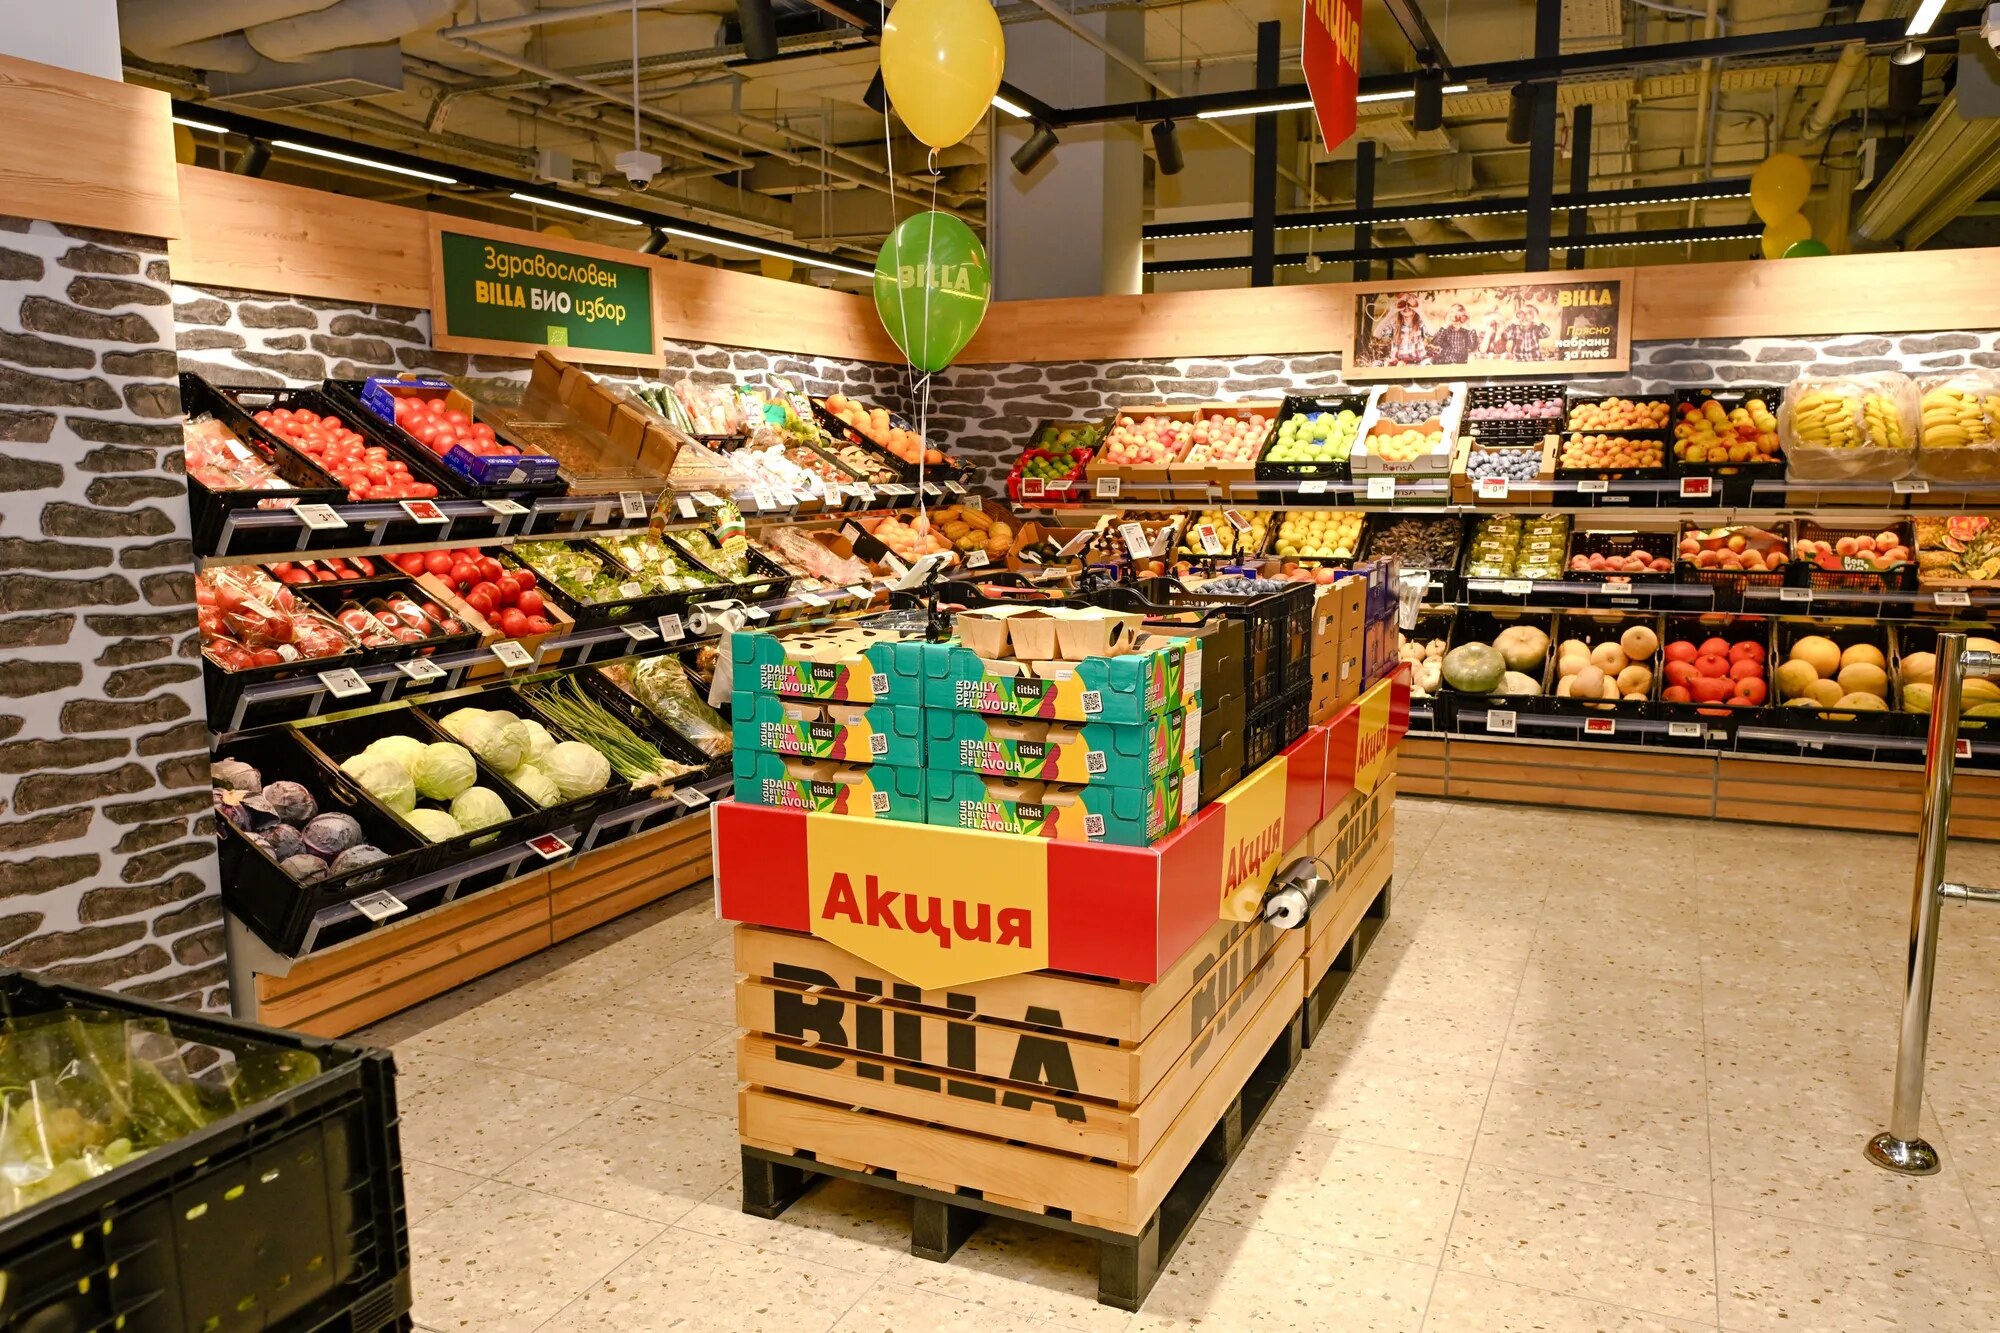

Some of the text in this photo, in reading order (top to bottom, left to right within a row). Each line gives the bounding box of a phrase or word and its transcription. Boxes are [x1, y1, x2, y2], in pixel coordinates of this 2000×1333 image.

[484, 246, 617, 288] Здравословен
[899, 264, 970, 292] BILLA
[475, 280, 626, 325] BILLA БИО избор
[1560, 289, 1612, 307] BILLA
[1566, 325, 1610, 336] Прясно
[1556, 336, 1610, 349] набрани
[1580, 347, 1609, 358] теб
[767, 664, 797, 676] DAILY
[813, 668, 834, 678] titbit
[767, 673, 778, 681] BIT
[767, 681, 815, 693] FLAVOUR
[963, 680, 997, 693] DAILY
[1016, 685, 1040, 696] titbit
[956, 680, 964, 707] YOUR
[963, 690, 976, 698] BIT
[963, 699, 1018, 712] FLAVOUR
[767, 722, 797, 734] DAILY
[812, 728, 833, 738] titbit
[767, 740, 814, 753] FLAVOUR
[960, 739, 968, 766] YOUR
[967, 740, 1002, 752] DAILY
[1019, 745, 1043, 756] titbit
[1357, 723, 1387, 773] Акция
[967, 749, 980, 757] BIT
[967, 758, 1021, 772] FLAVOUR
[769, 778, 798, 790] DAILY
[813, 785, 834, 795] titbit
[769, 795, 816, 809] FLAVOUR
[967, 800, 1001, 813] DAILY
[959, 800, 967, 826] YOUR
[1018, 807, 1042, 818] titbit
[967, 819, 1021, 833] FLAVOUR
[1336, 779, 1379, 893] BILLA
[1224, 816, 1281, 899] Акция
[821, 871, 1032, 949] Акция
[1190, 921, 1275, 1070] BILLA
[773, 962, 1087, 1123] BILLA
